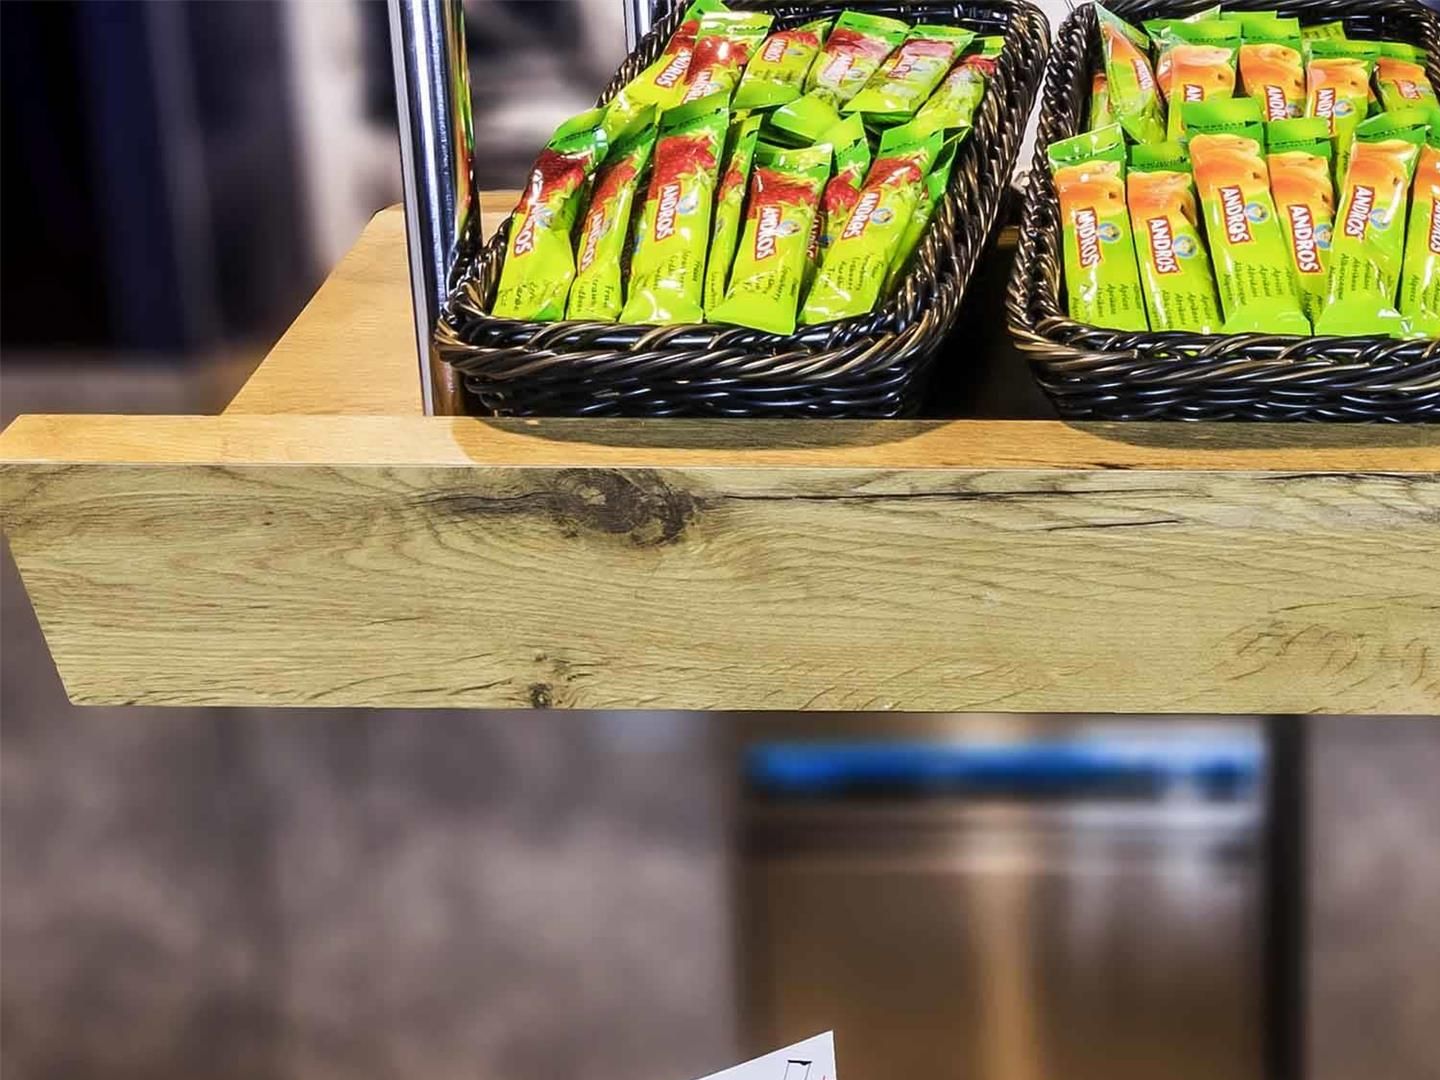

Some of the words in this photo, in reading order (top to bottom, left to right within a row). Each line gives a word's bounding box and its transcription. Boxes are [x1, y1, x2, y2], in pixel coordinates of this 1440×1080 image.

[1221, 186, 1250, 242] ANDROS
[1290, 205, 1319, 271] ANDROS
[1149, 217, 1178, 273] ANDROS
